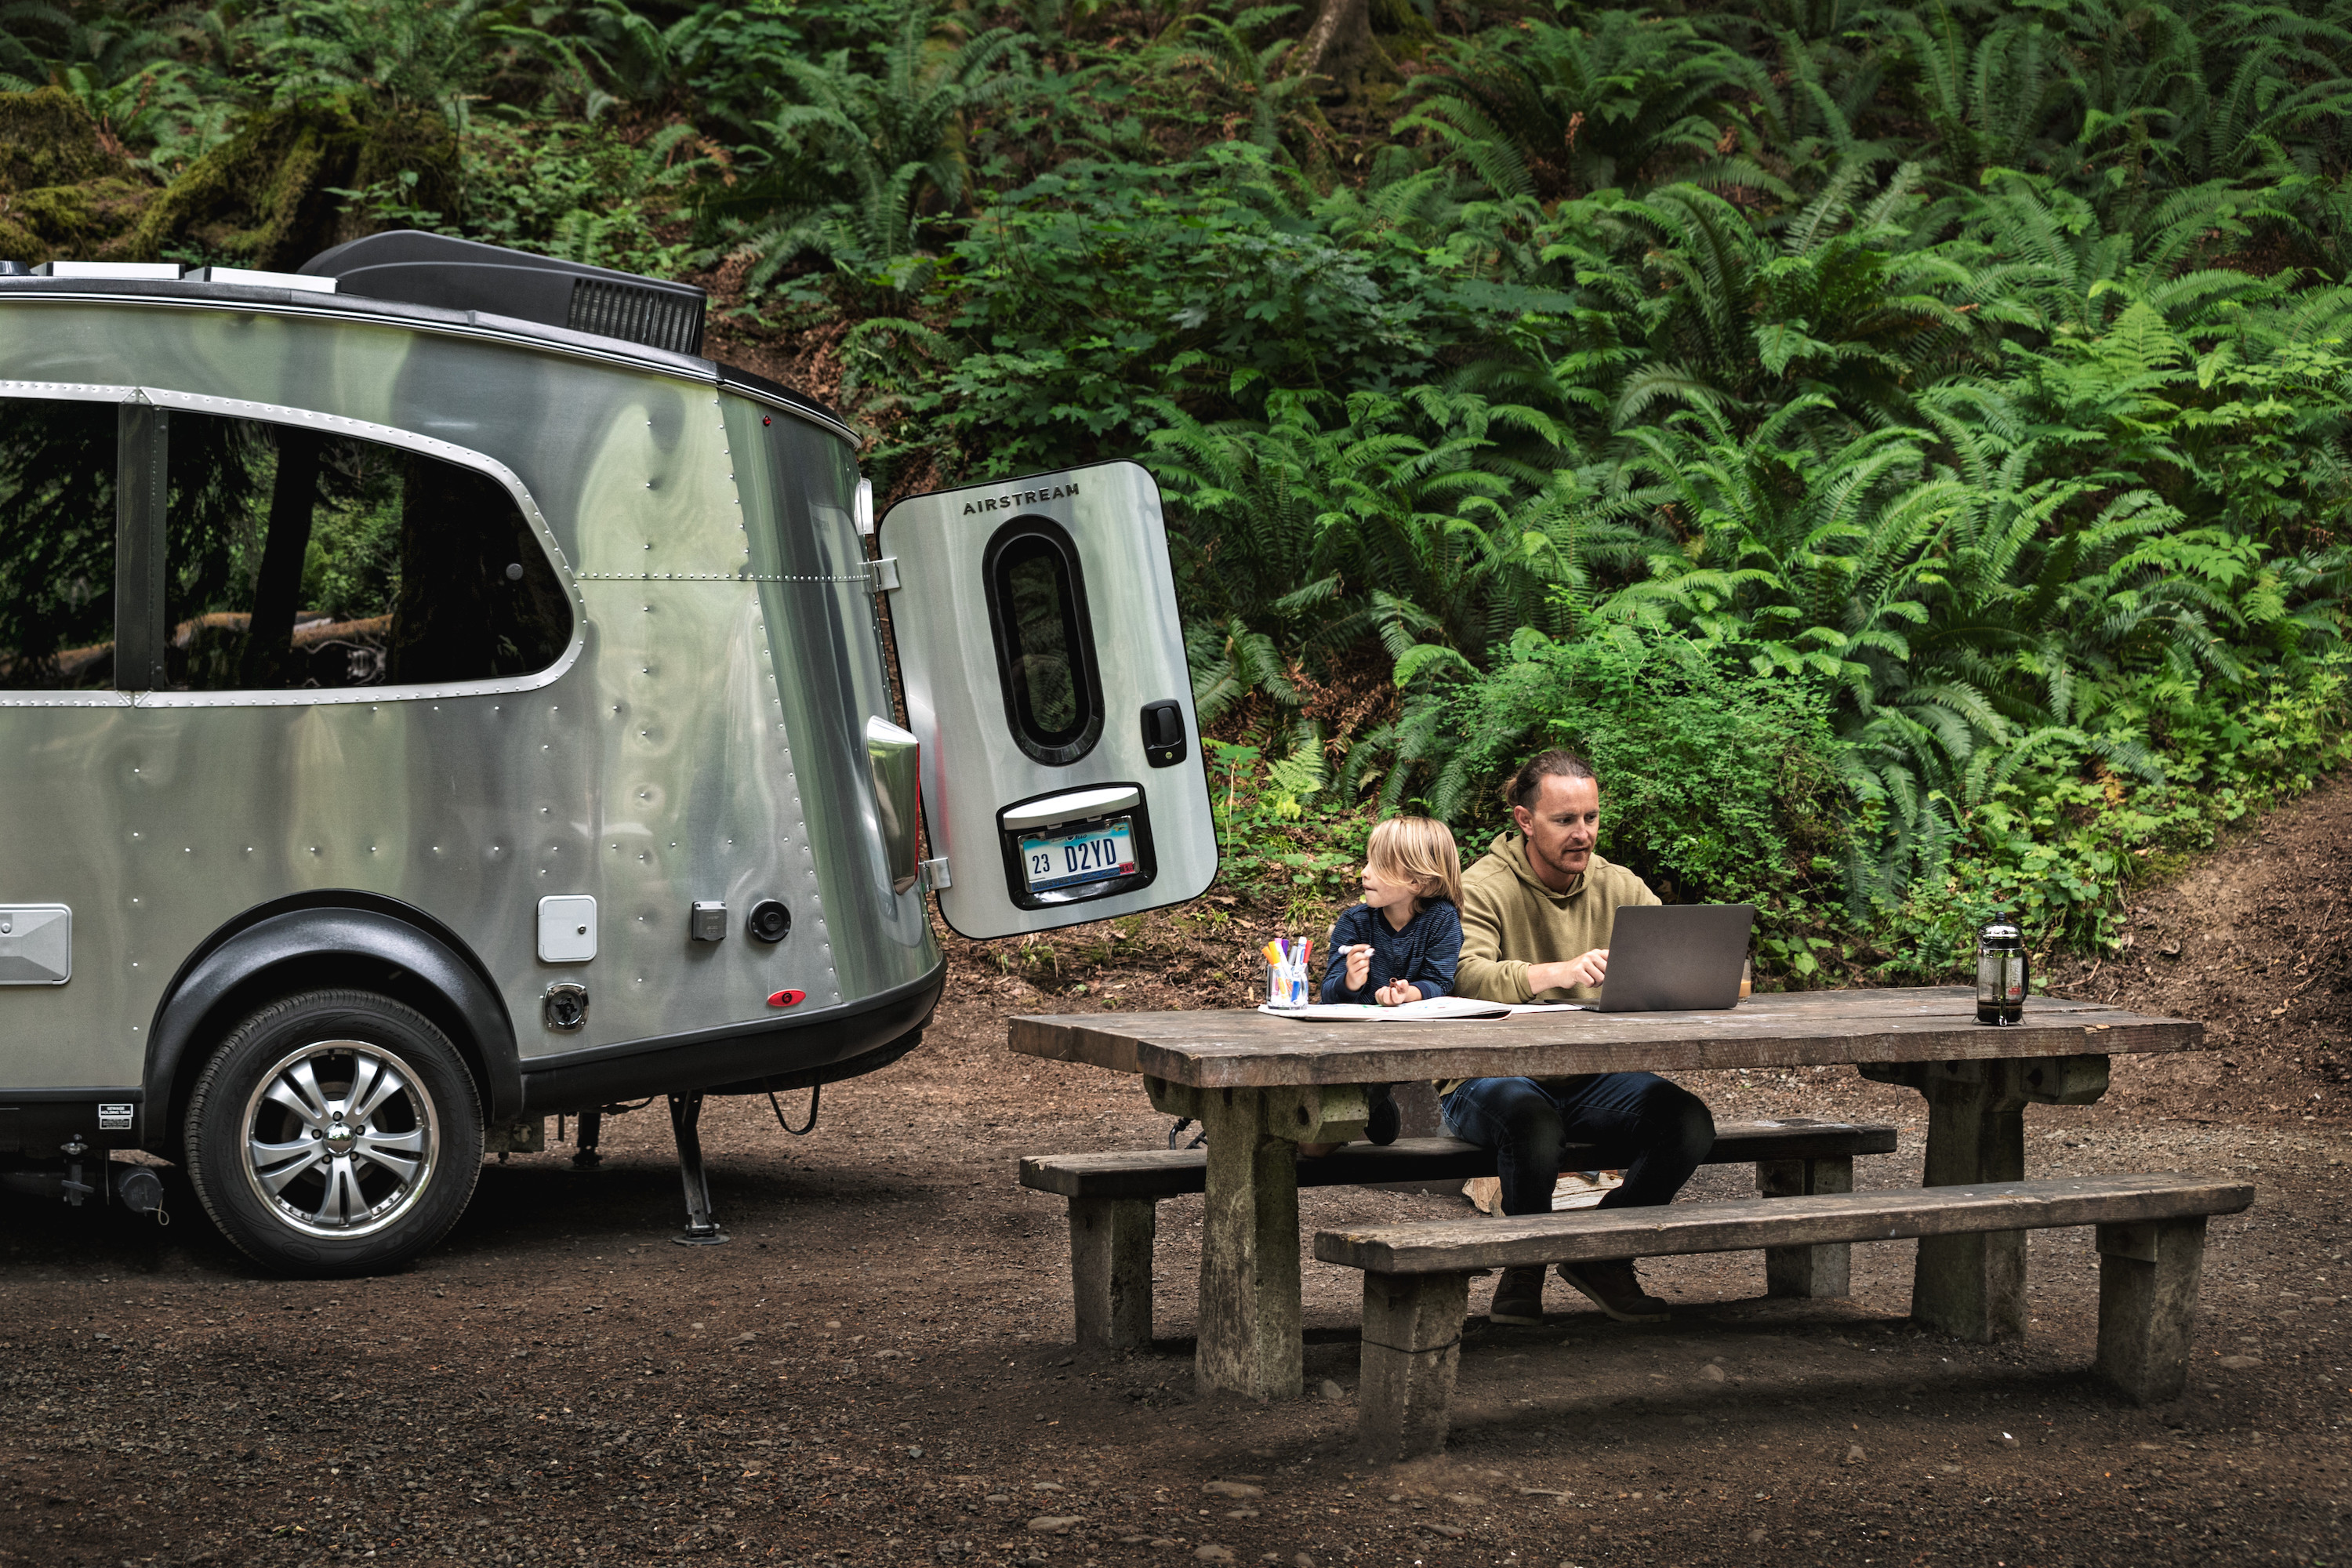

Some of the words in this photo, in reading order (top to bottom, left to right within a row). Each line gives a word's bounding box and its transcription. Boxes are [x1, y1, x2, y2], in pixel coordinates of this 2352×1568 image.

[963, 483, 1080, 516] AIRSTREAM
[1032, 853, 1051, 875] 23
[1064, 838, 1116, 873] D2YD
[1033, 875, 1083, 890] AIRSTREAM
